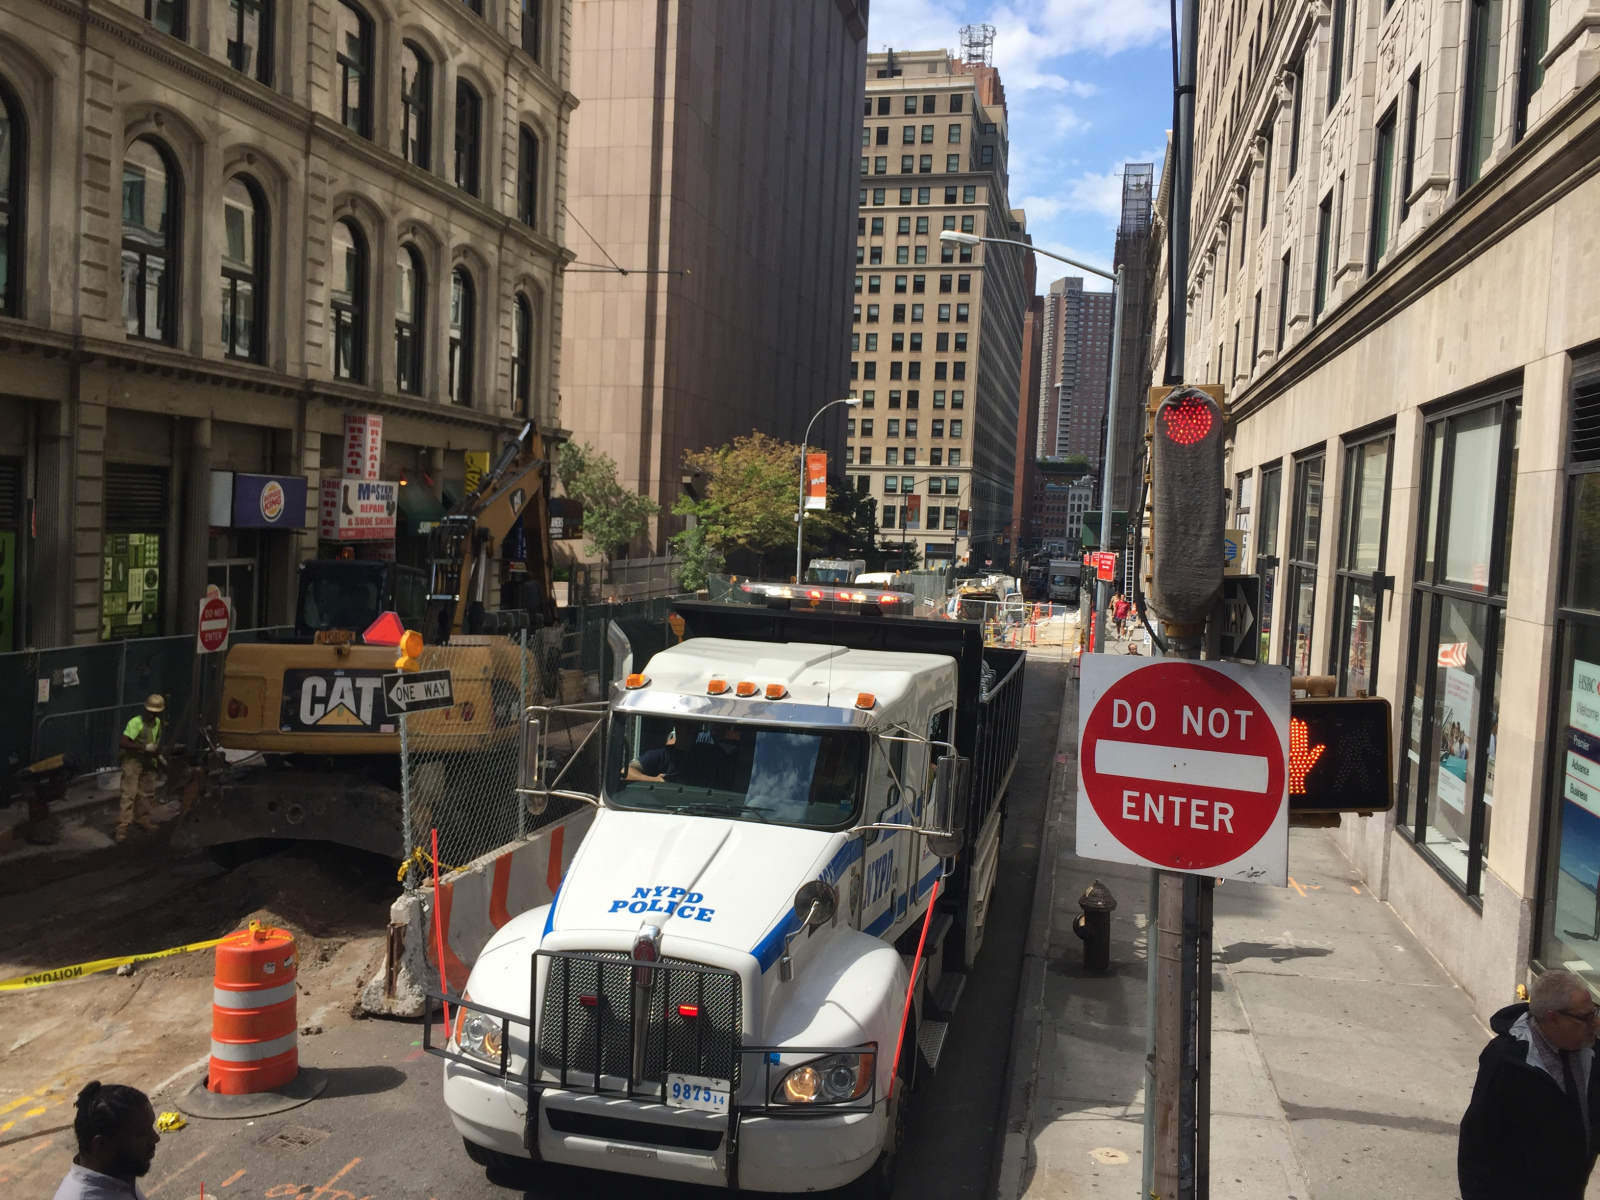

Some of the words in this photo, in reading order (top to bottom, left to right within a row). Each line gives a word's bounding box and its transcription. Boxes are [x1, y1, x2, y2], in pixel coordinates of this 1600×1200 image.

[368, 429, 379, 477] REPAIR
[322, 480, 340, 489] SHOE
[264, 489, 281, 502] BURGER
[264, 497, 281, 511] KING
[360, 504, 385, 513] REPAIR
[355, 517, 373, 526] SHOE
[375, 517, 394, 526] SHINE
[205, 609, 213, 618] DO
[214, 607, 225, 617] NOT
[205, 631, 222, 641] ENTER
[396, 685, 416, 701] ONE
[424, 682, 447, 698] WAY
[1578, 674, 1596, 694] HSBC
[300, 676, 382, 725] CAT
[1112, 698, 1157, 731] DO
[1182, 705, 1253, 741] NOT
[1576, 701, 1599, 722] Welcome
[1573, 734, 1590, 751] Premier
[1571, 758, 1590, 776] Advance
[1569, 783, 1588, 801] Business
[1122, 790, 1235, 834] ENTER
[862, 849, 894, 911] NYPD
[631, 886, 704, 904] NYPD
[608, 899, 715, 922] POLICE
[672, 1082, 711, 1102] 9875
[713, 1095, 725, 1105] 14
